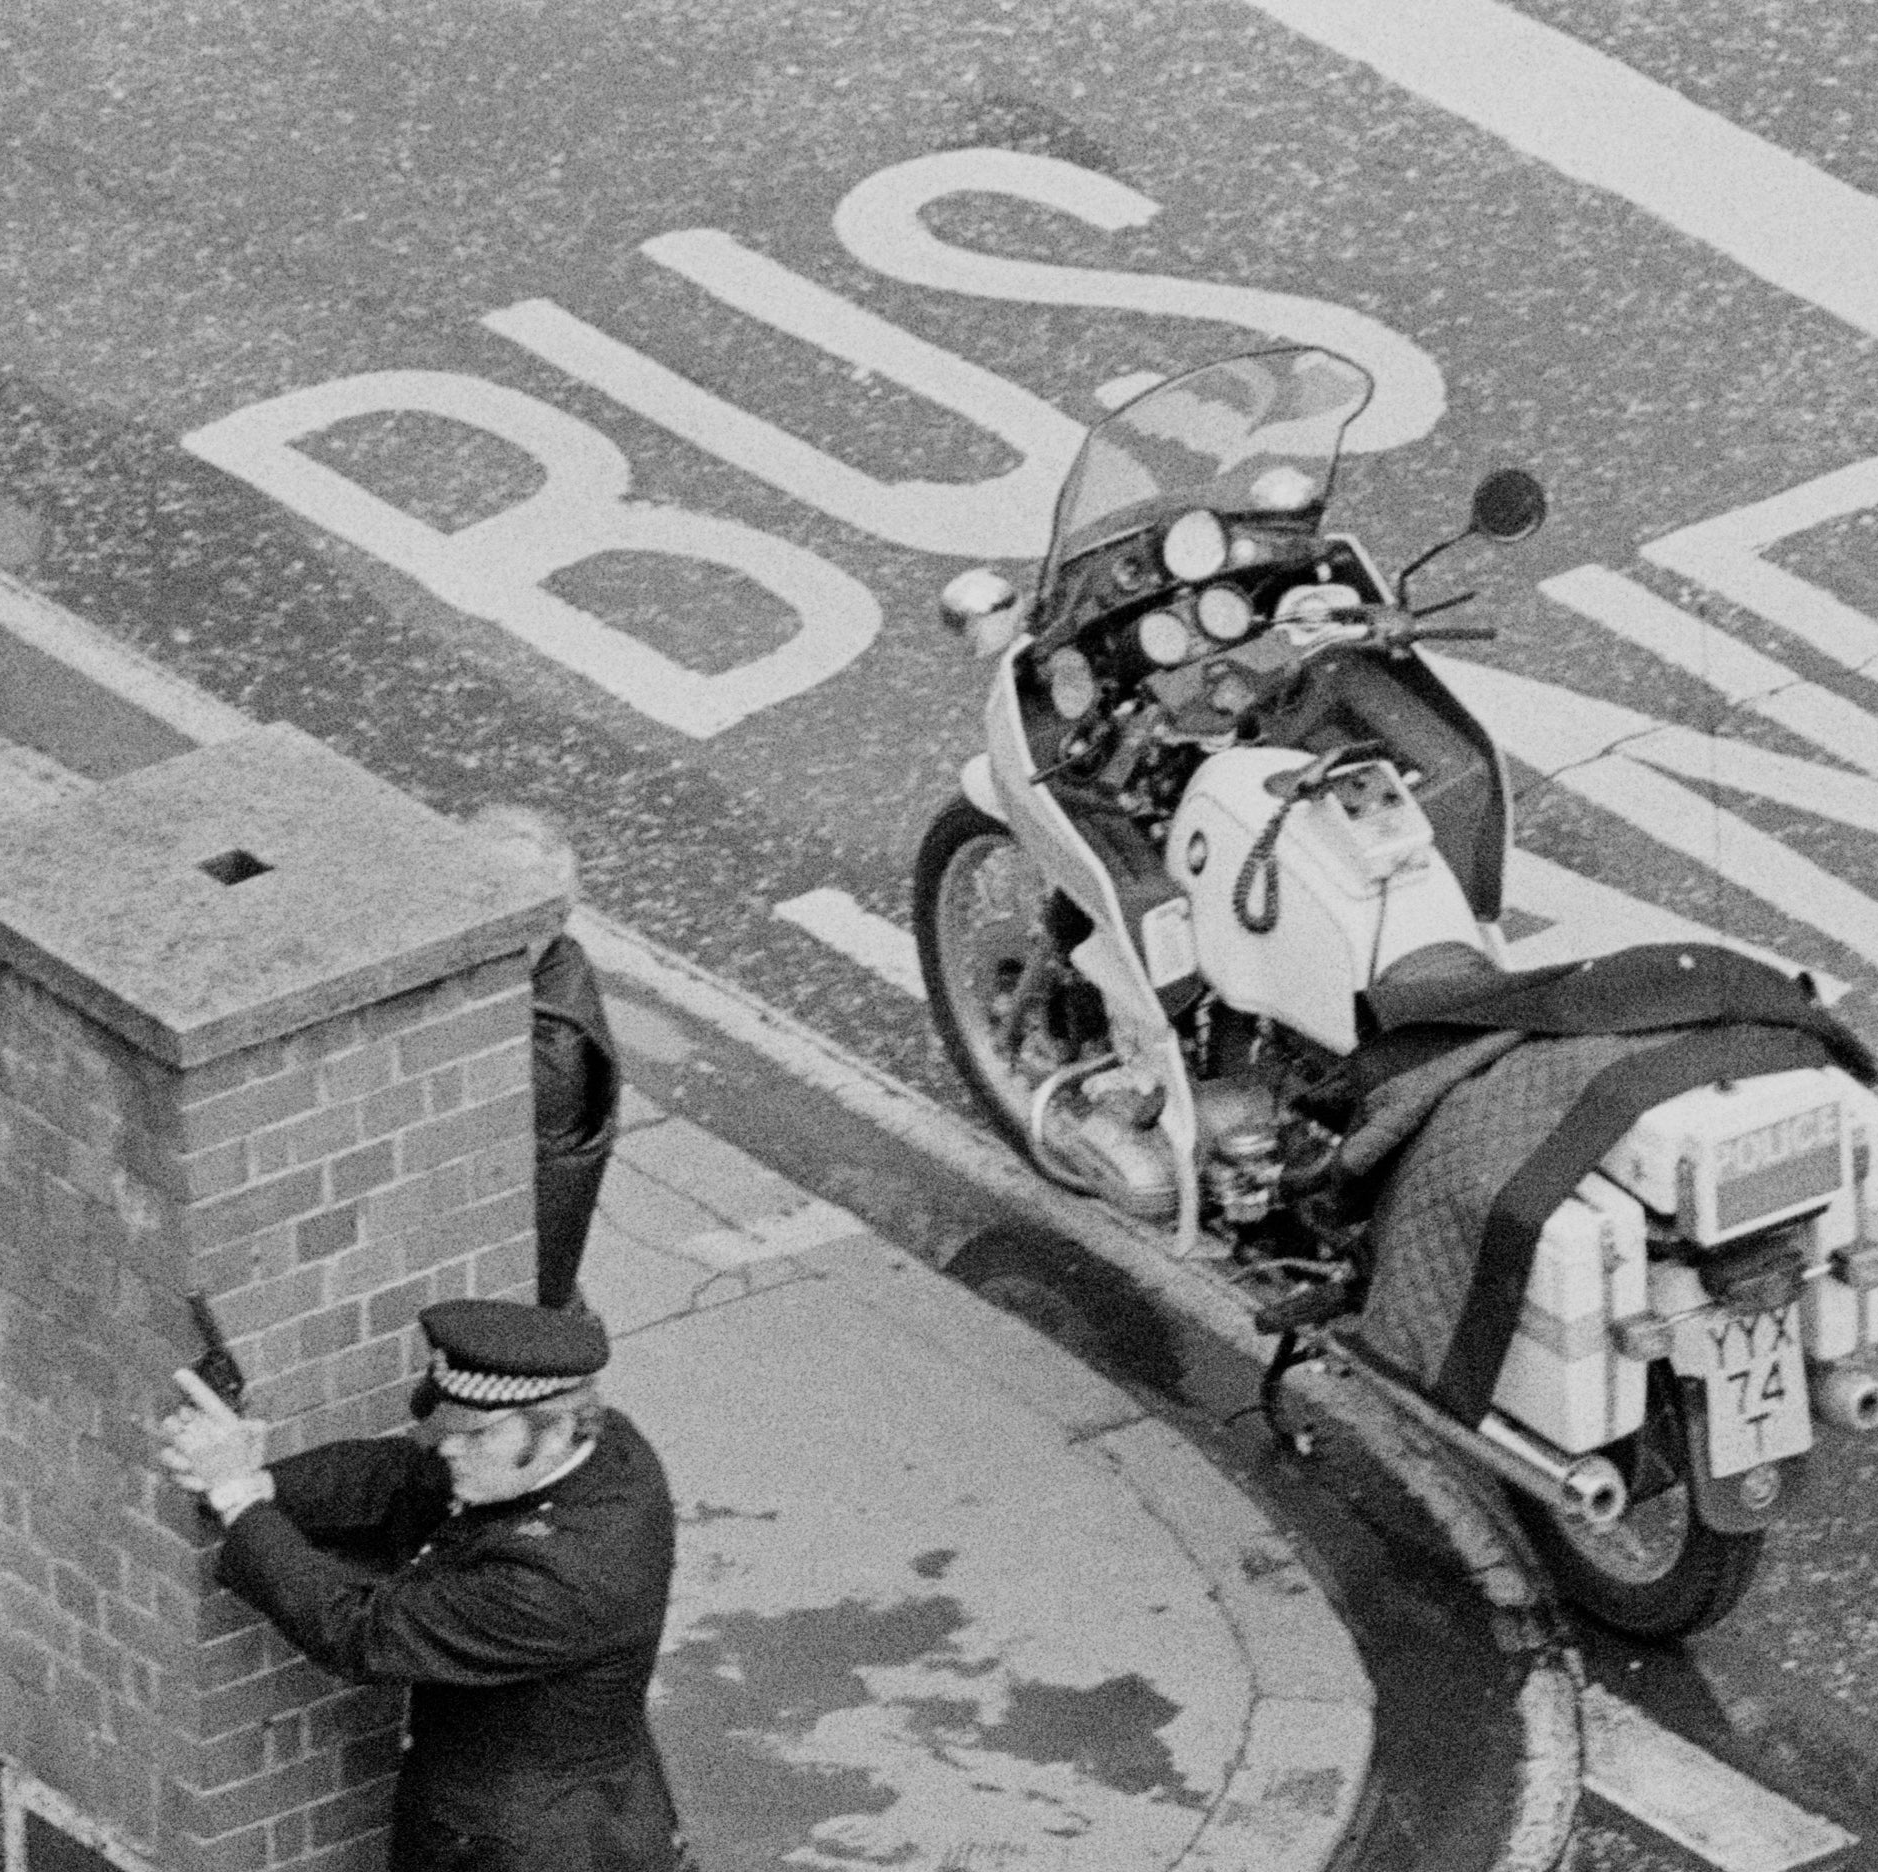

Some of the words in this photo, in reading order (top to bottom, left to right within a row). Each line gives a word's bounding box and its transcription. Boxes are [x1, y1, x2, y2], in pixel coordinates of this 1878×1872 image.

[181, 148, 1448, 738] BUS
[1714, 1102, 1841, 1179] POLICE
[1706, 1307, 1794, 1370] YYX
[1726, 1361, 1786, 1414] 74
[1745, 1411, 1772, 1453] T
